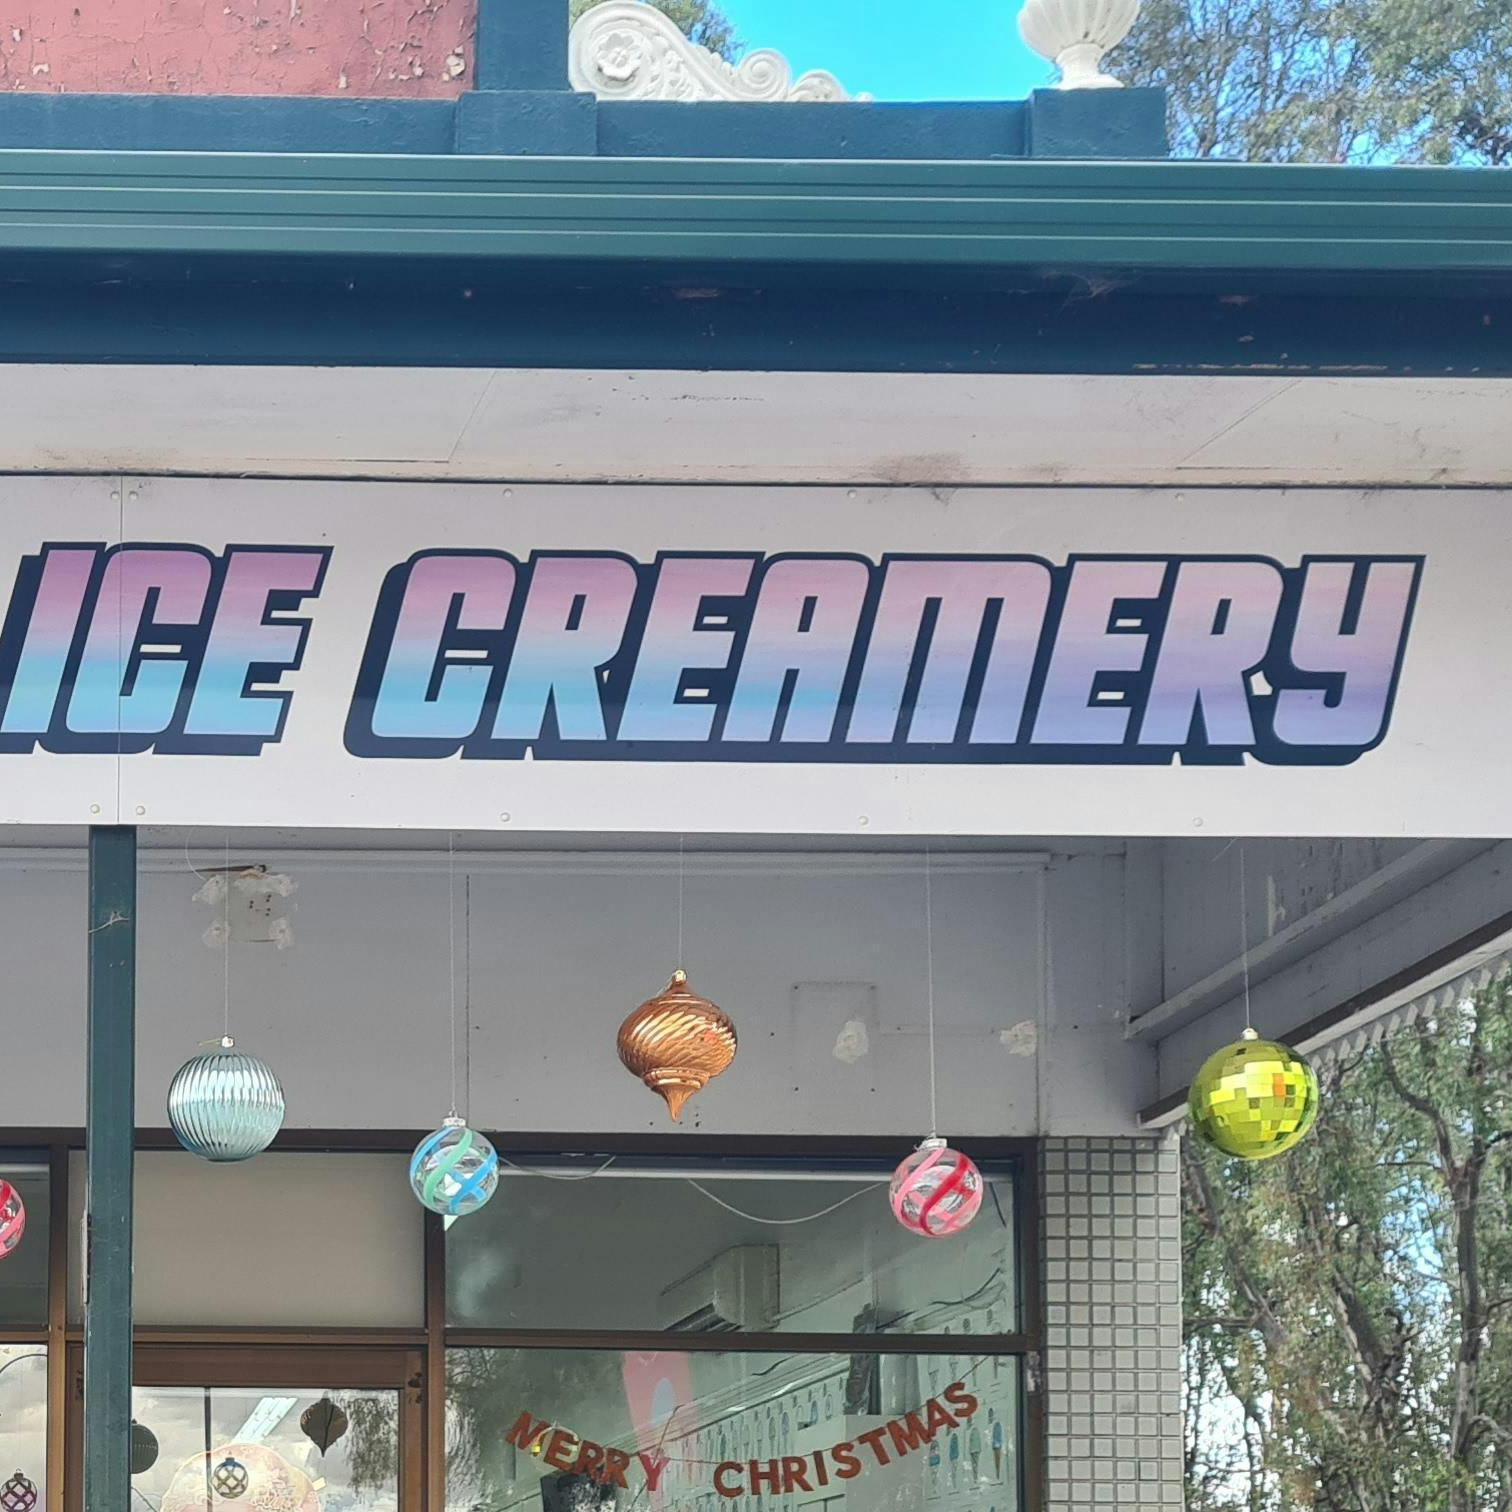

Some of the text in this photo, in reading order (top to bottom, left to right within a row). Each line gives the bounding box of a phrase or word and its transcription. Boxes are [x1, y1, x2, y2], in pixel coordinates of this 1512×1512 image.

[343, 548, 1426, 765] CREAMERY
[505, 1382, 978, 1498] MERRY CHRISTMAS
